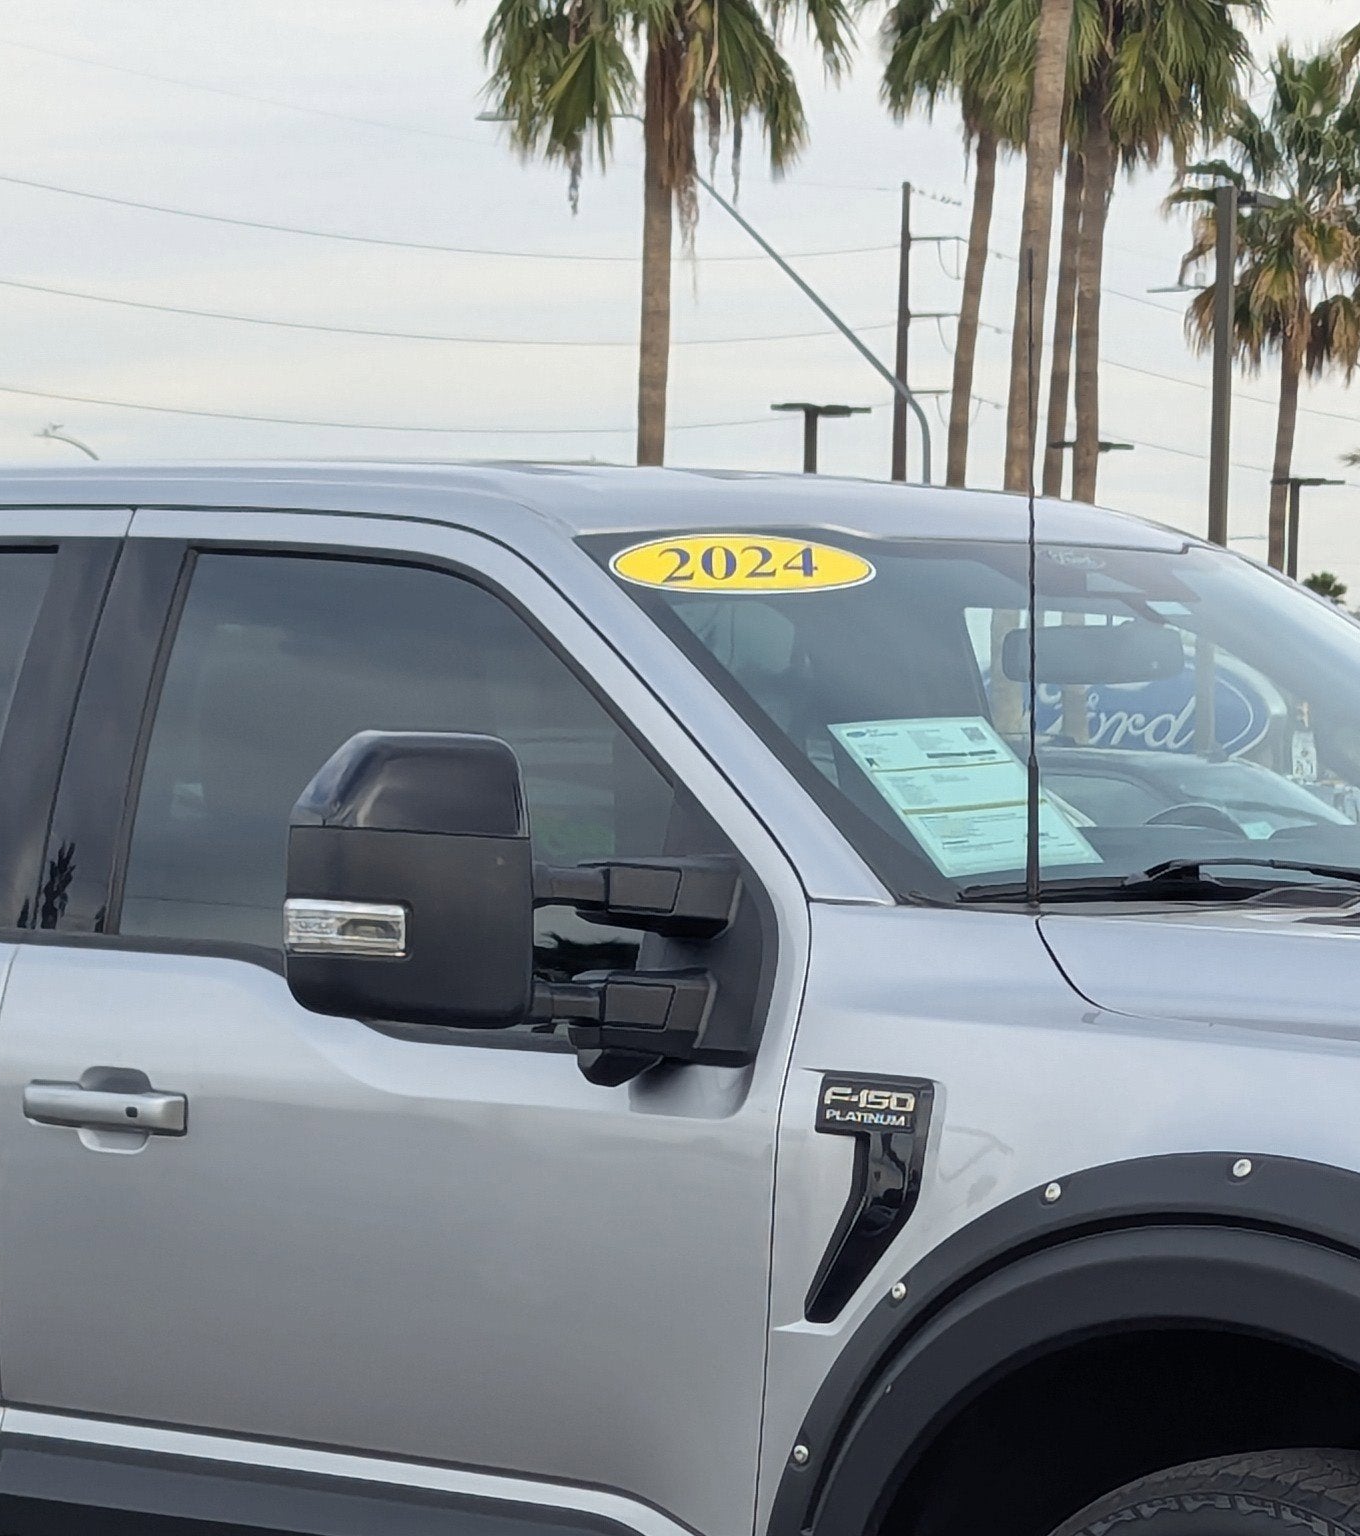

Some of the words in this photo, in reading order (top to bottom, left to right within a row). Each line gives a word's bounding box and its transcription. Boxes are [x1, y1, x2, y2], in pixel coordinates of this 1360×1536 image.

[658, 545, 818, 584] 2024
[1038, 682, 1197, 749] ord
[823, 1086, 916, 1112] F-150
[825, 1108, 906, 1127] PLATINUM
